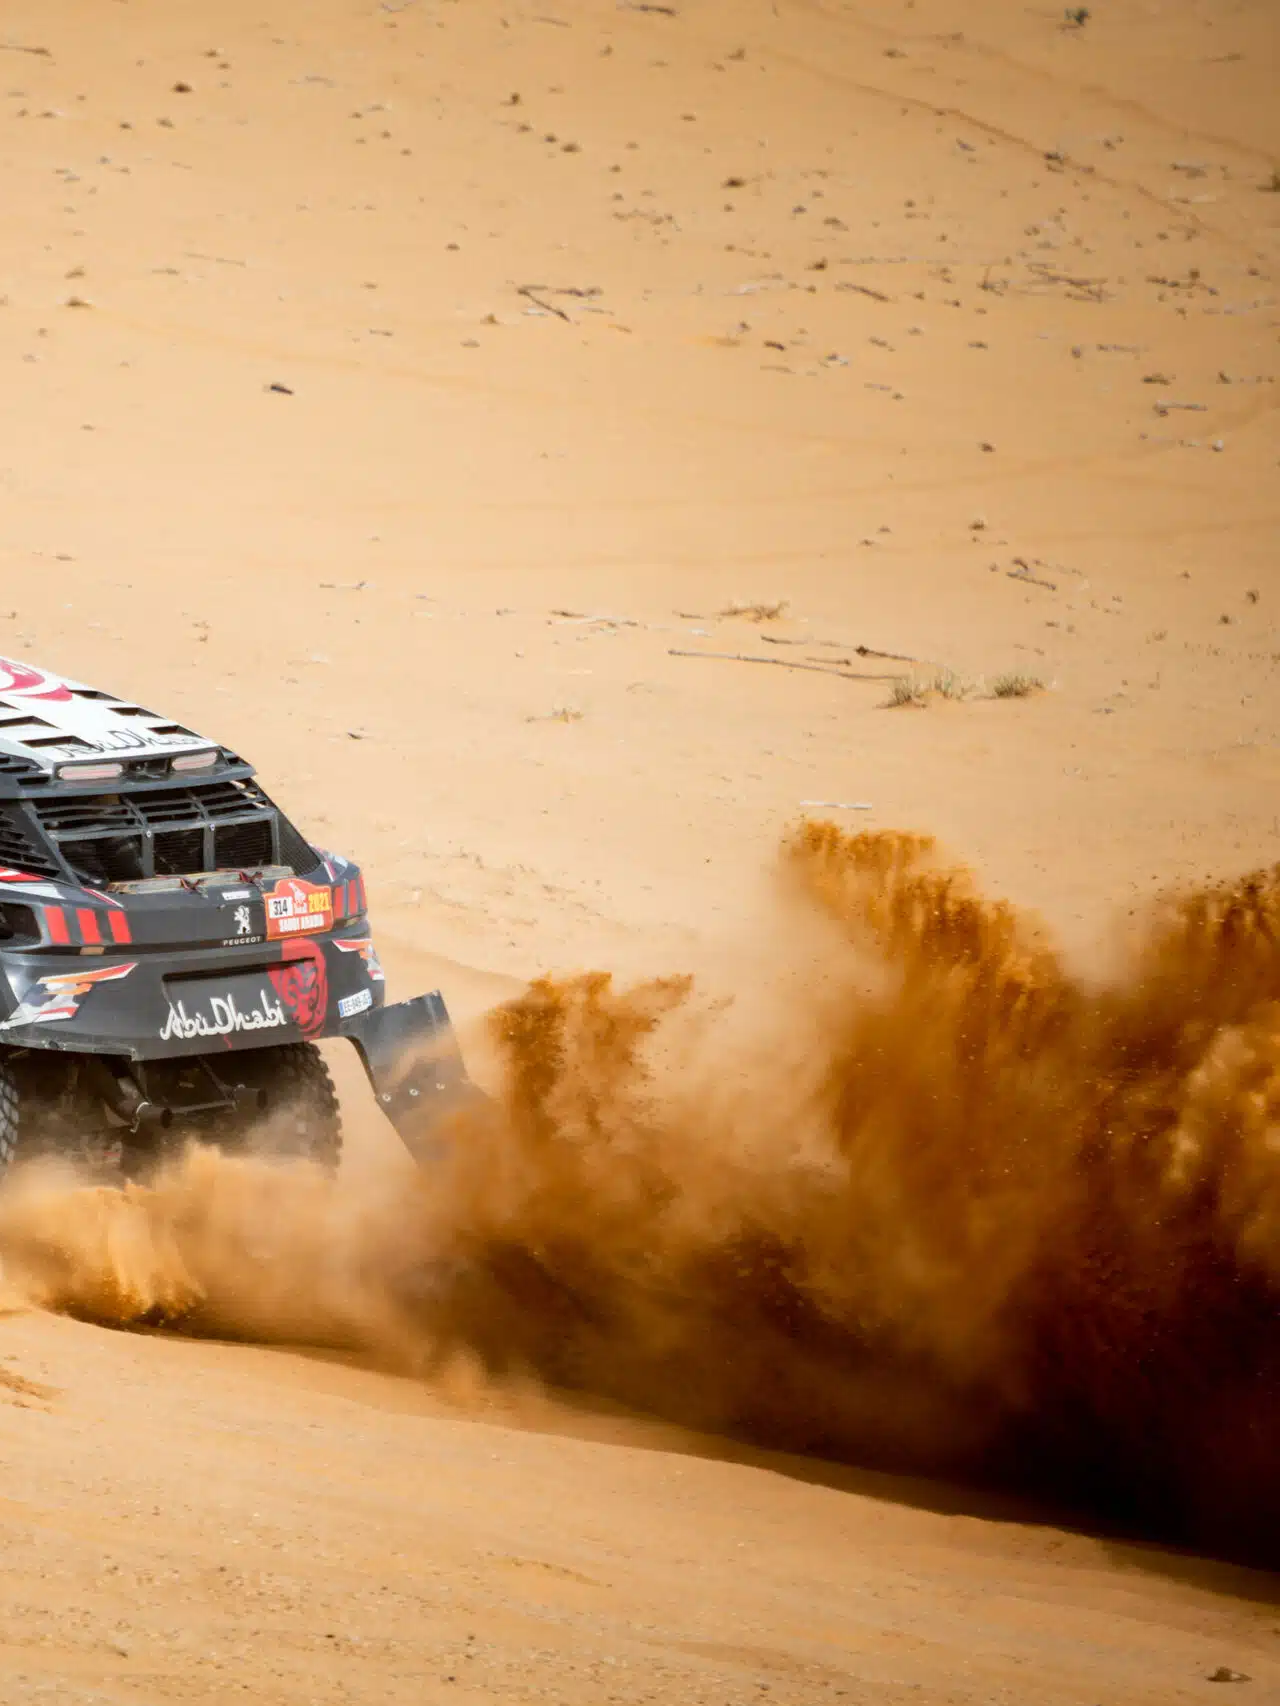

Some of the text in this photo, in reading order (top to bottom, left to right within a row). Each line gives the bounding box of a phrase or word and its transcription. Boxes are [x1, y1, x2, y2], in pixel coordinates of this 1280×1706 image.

[273, 899, 288, 916] 314
[308, 892, 331, 913] 2021
[222, 936, 261, 946] PEUGEOT
